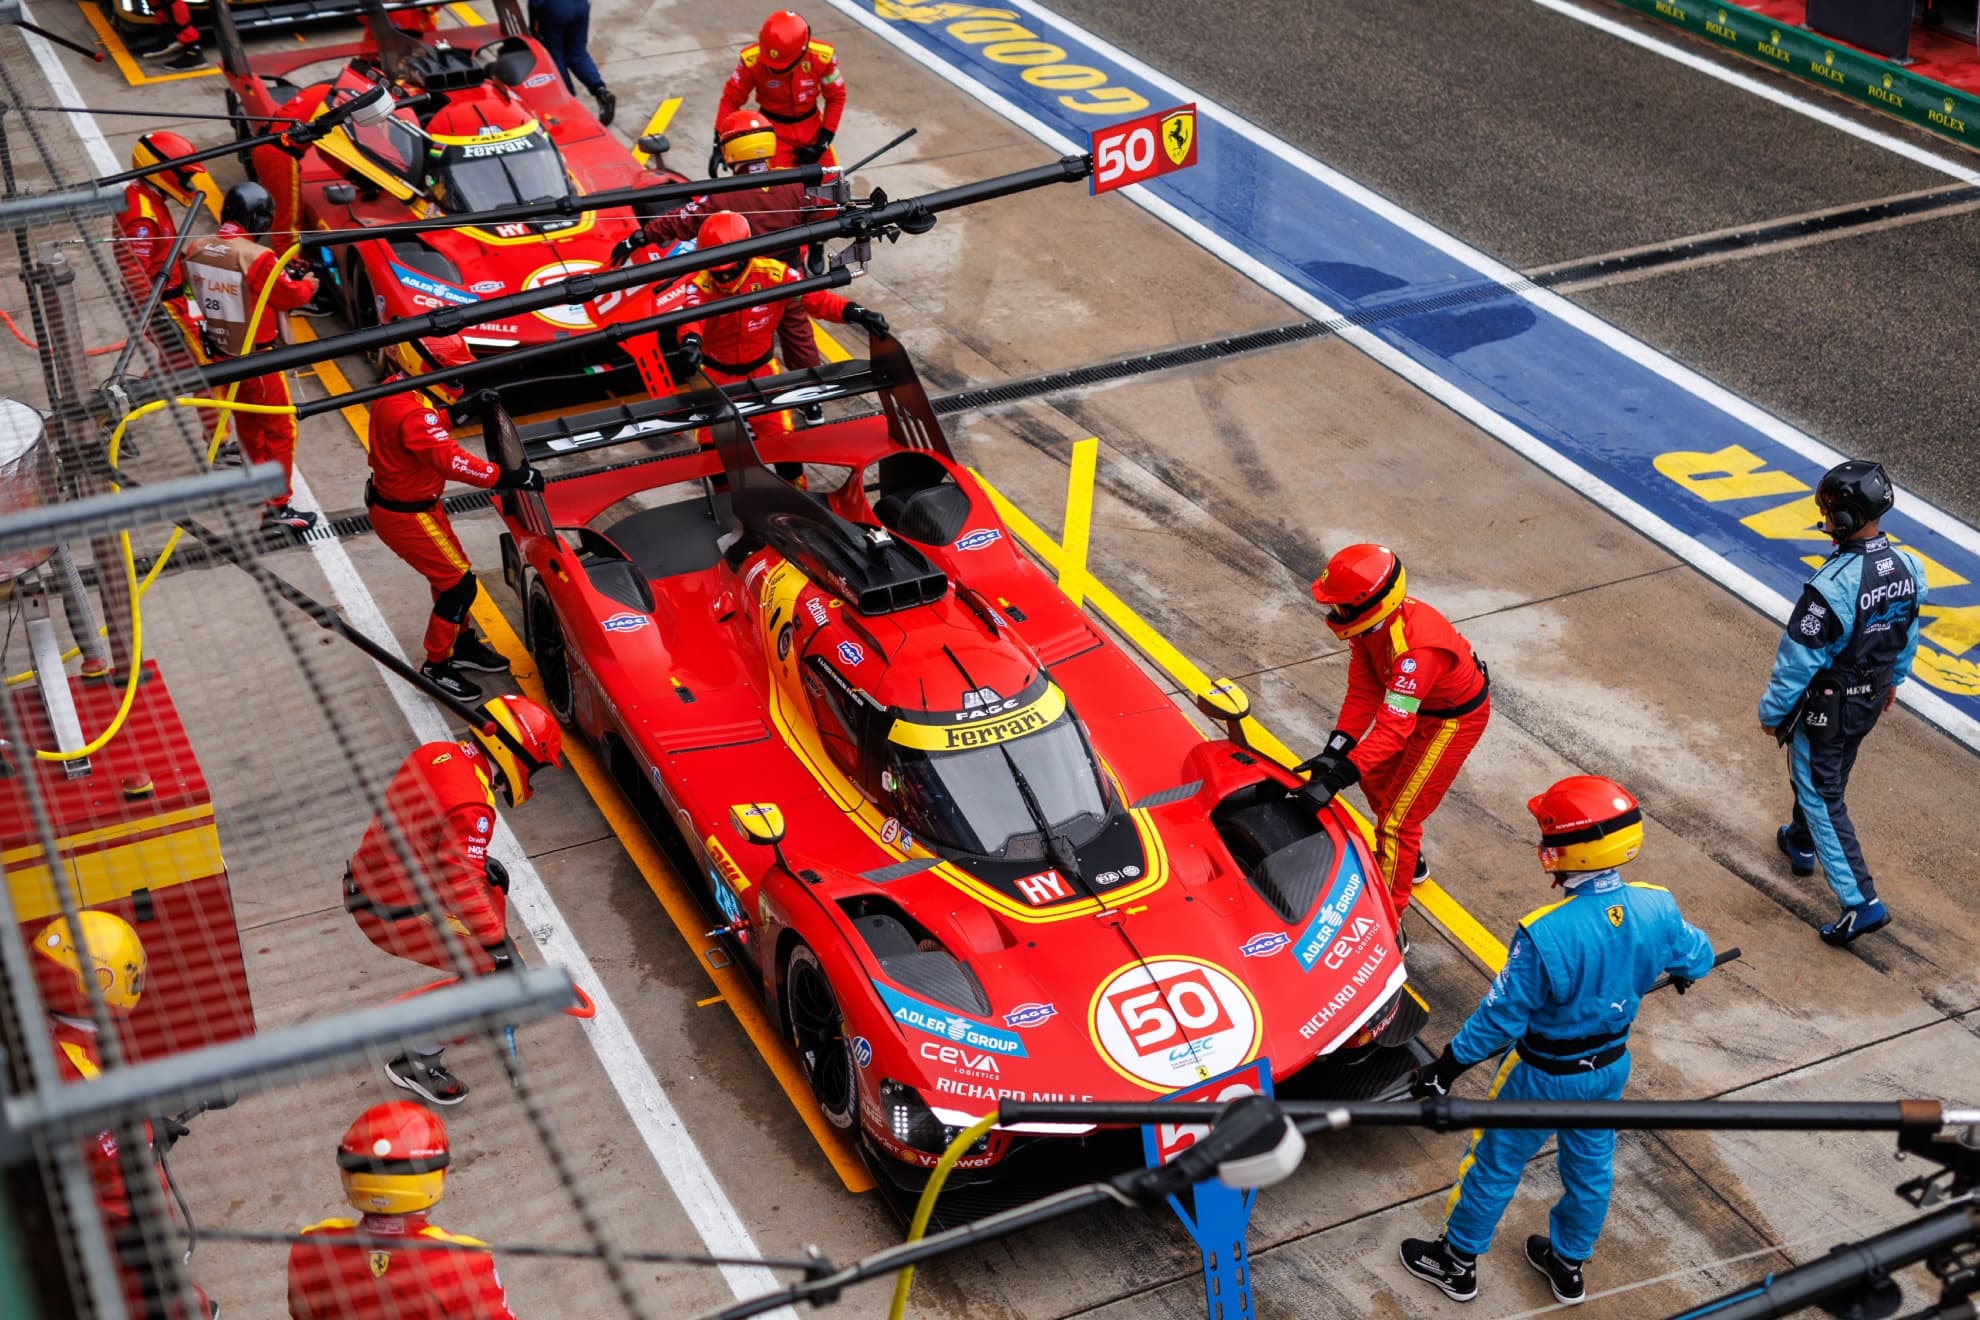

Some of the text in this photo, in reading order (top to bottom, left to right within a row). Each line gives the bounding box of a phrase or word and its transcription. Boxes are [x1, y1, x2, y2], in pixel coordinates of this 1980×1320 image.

[1706, 21, 1736, 42] ROLEX
[1758, 41, 1790, 63] ROLEX
[1811, 61, 1845, 84] ROLEX
[1868, 84, 1903, 108] ROLEX
[1928, 109, 1965, 133] ROLEX
[463, 138, 534, 157] Ferrari
[1099, 128, 1155, 183] 50
[497, 224, 526, 237] HY
[208, 279, 238, 296] LANE
[401, 276, 433, 293] ADLER
[205, 298, 220, 311] 28
[480, 323, 518, 333] MILLE
[962, 532, 996, 547] FAGE
[609, 618, 644, 628] FAGE
[806, 597, 829, 627] Cetilar
[841, 644, 860, 664] FAGE
[956, 699, 1019, 721] FAGE
[945, 708, 1048, 748] Ferrari
[1018, 872, 1065, 903] HY
[1097, 872, 1118, 884] FIA
[1302, 873, 1361, 964] ADLER GROUP
[1247, 935, 1286, 953] FAGE
[1356, 923, 1381, 954] LOGISTICS
[1299, 944, 1388, 1039] RICHARD MILLE
[1011, 1008, 1050, 1023] FAGE
[1121, 981, 1219, 1048] 50
[895, 1008, 1018, 1052] ADLER GROUP
[853, 1037, 870, 1067] hp
[954, 1067, 1000, 1081] LOGISTICS
